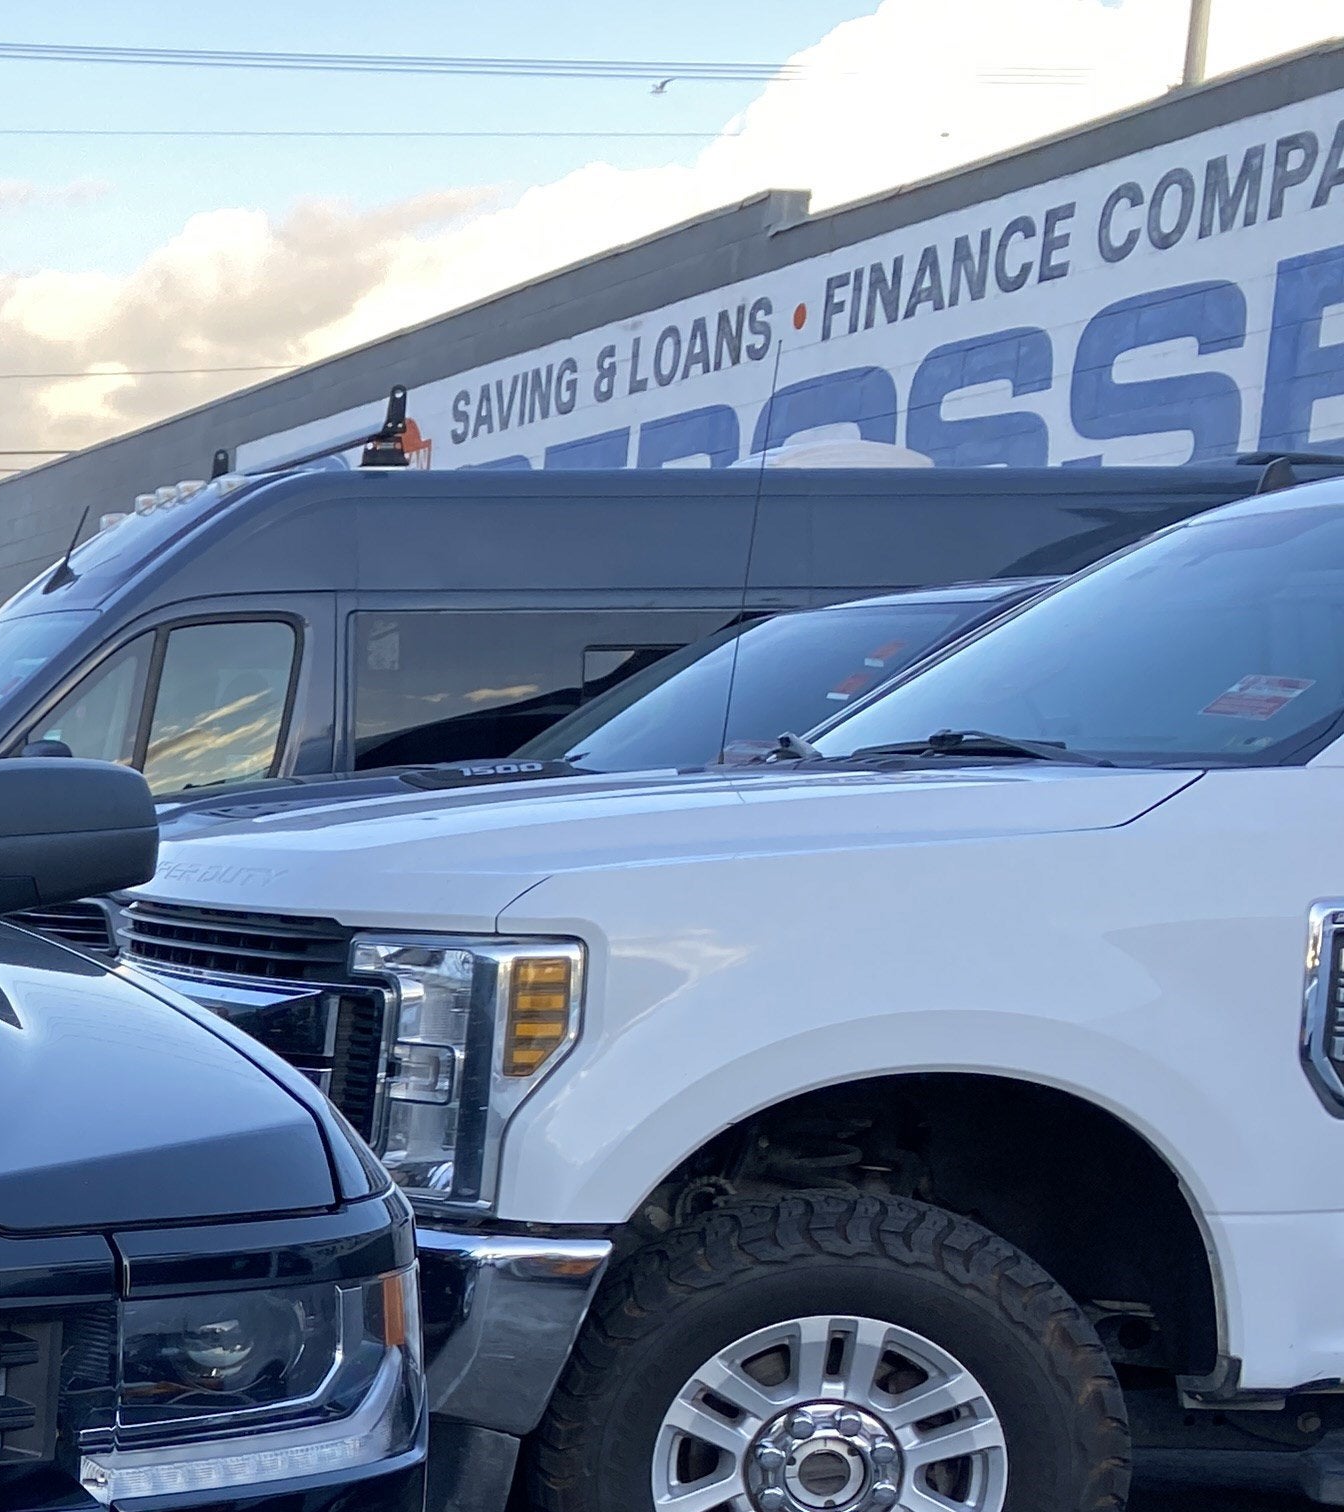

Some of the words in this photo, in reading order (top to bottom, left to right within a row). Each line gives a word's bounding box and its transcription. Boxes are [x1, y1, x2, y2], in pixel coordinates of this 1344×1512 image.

[450, 357, 578, 445] SAVING
[593, 345, 617, 402] &
[628, 296, 773, 395] LOANS
[821, 202, 1075, 342] FINANCE
[458, 762, 543, 777] 1500
